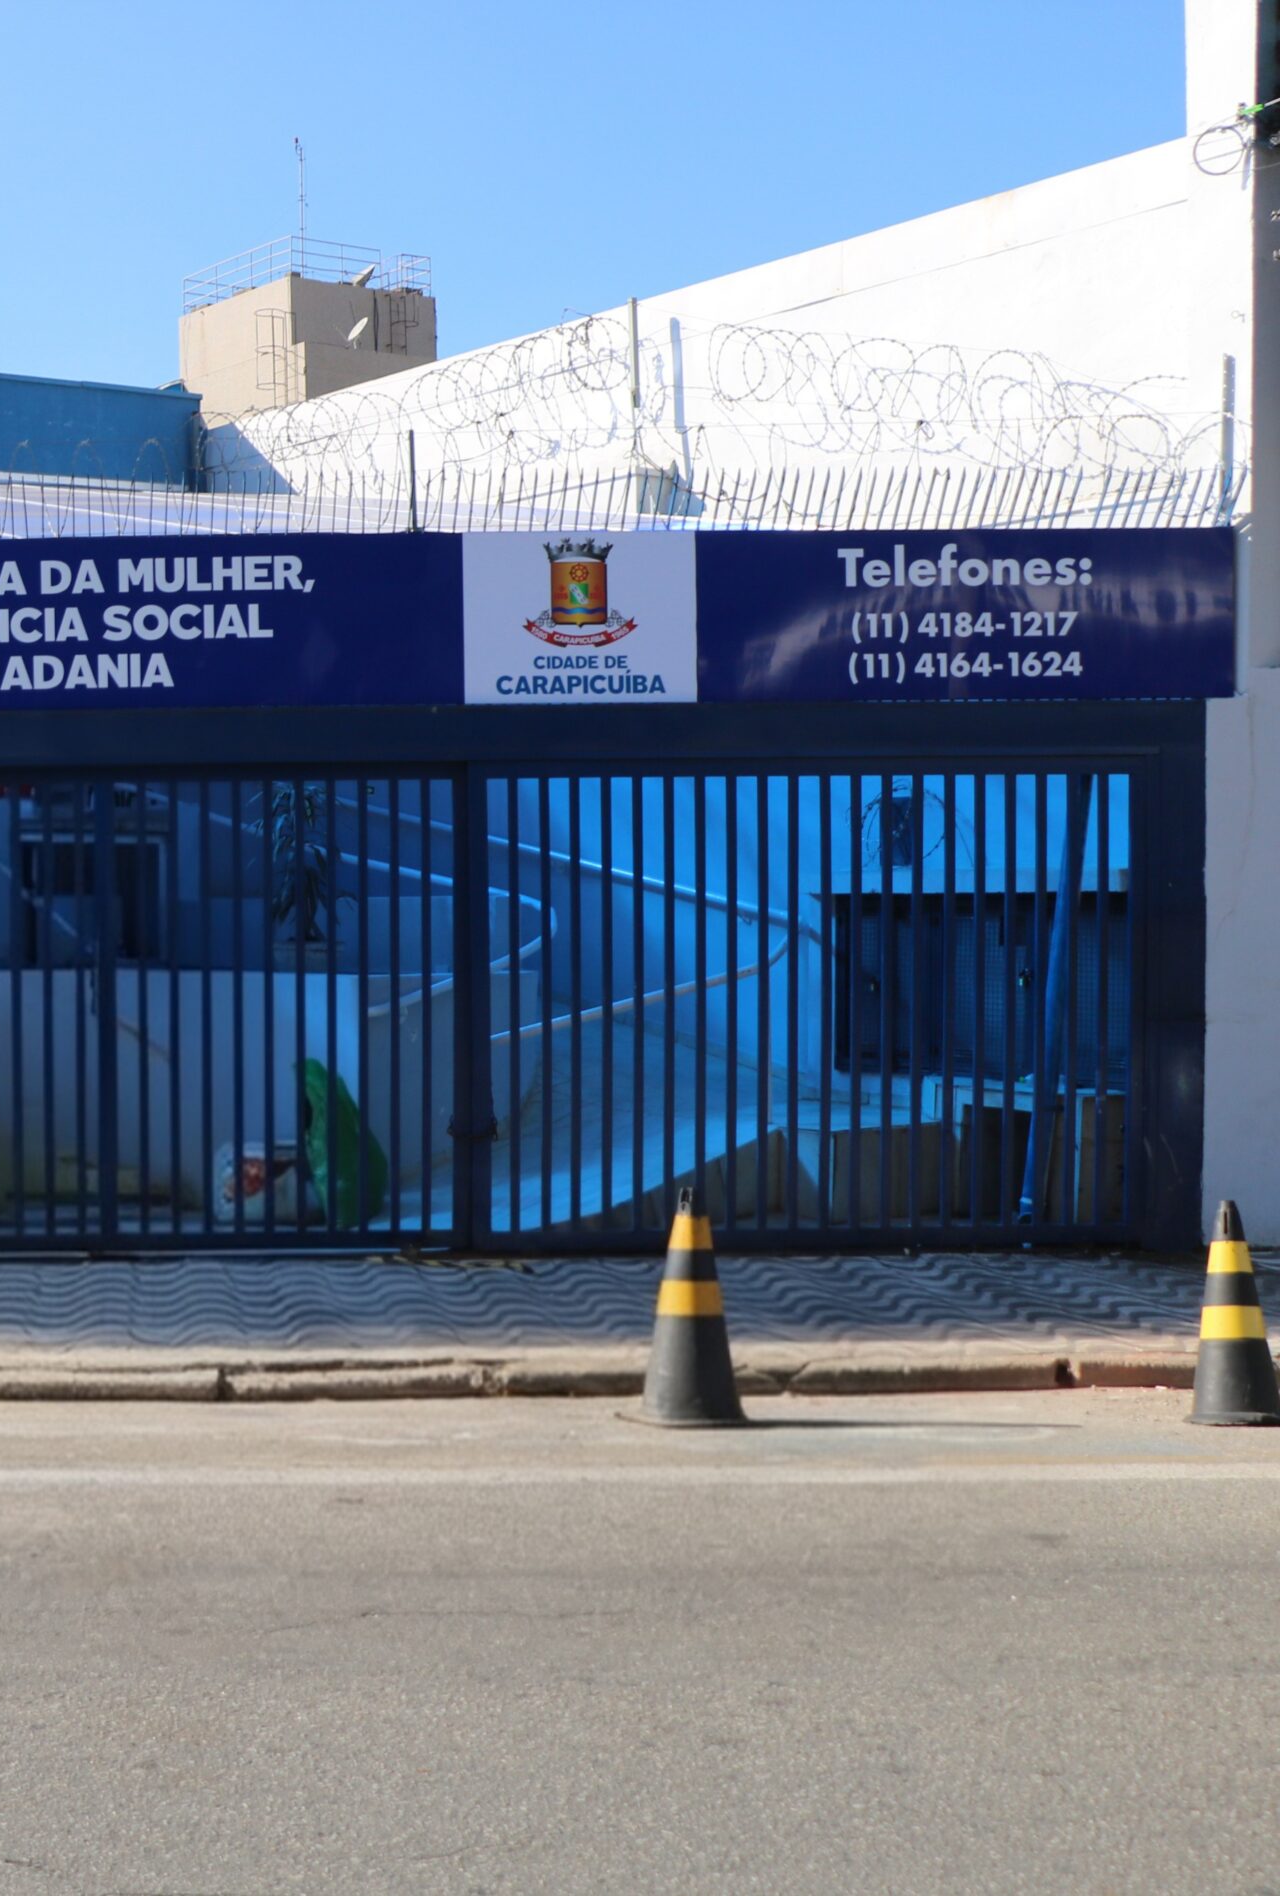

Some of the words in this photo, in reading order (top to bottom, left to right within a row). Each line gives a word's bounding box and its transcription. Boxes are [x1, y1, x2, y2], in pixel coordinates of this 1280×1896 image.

[40, 558, 105, 594] DA
[118, 555, 315, 593] MULHER,
[837, 543, 1093, 588] Telefones:
[102, 603, 273, 642] SOCIAL
[851, 611, 910, 644] (11)
[917, 610, 1079, 638] 4184-1217
[533, 655, 599, 670] CIDADE
[604, 655, 628, 669] DE
[848, 651, 906, 684] (11)
[914, 651, 1083, 679] 4164-1624
[496, 669, 666, 695] CARAPICUÍBA
